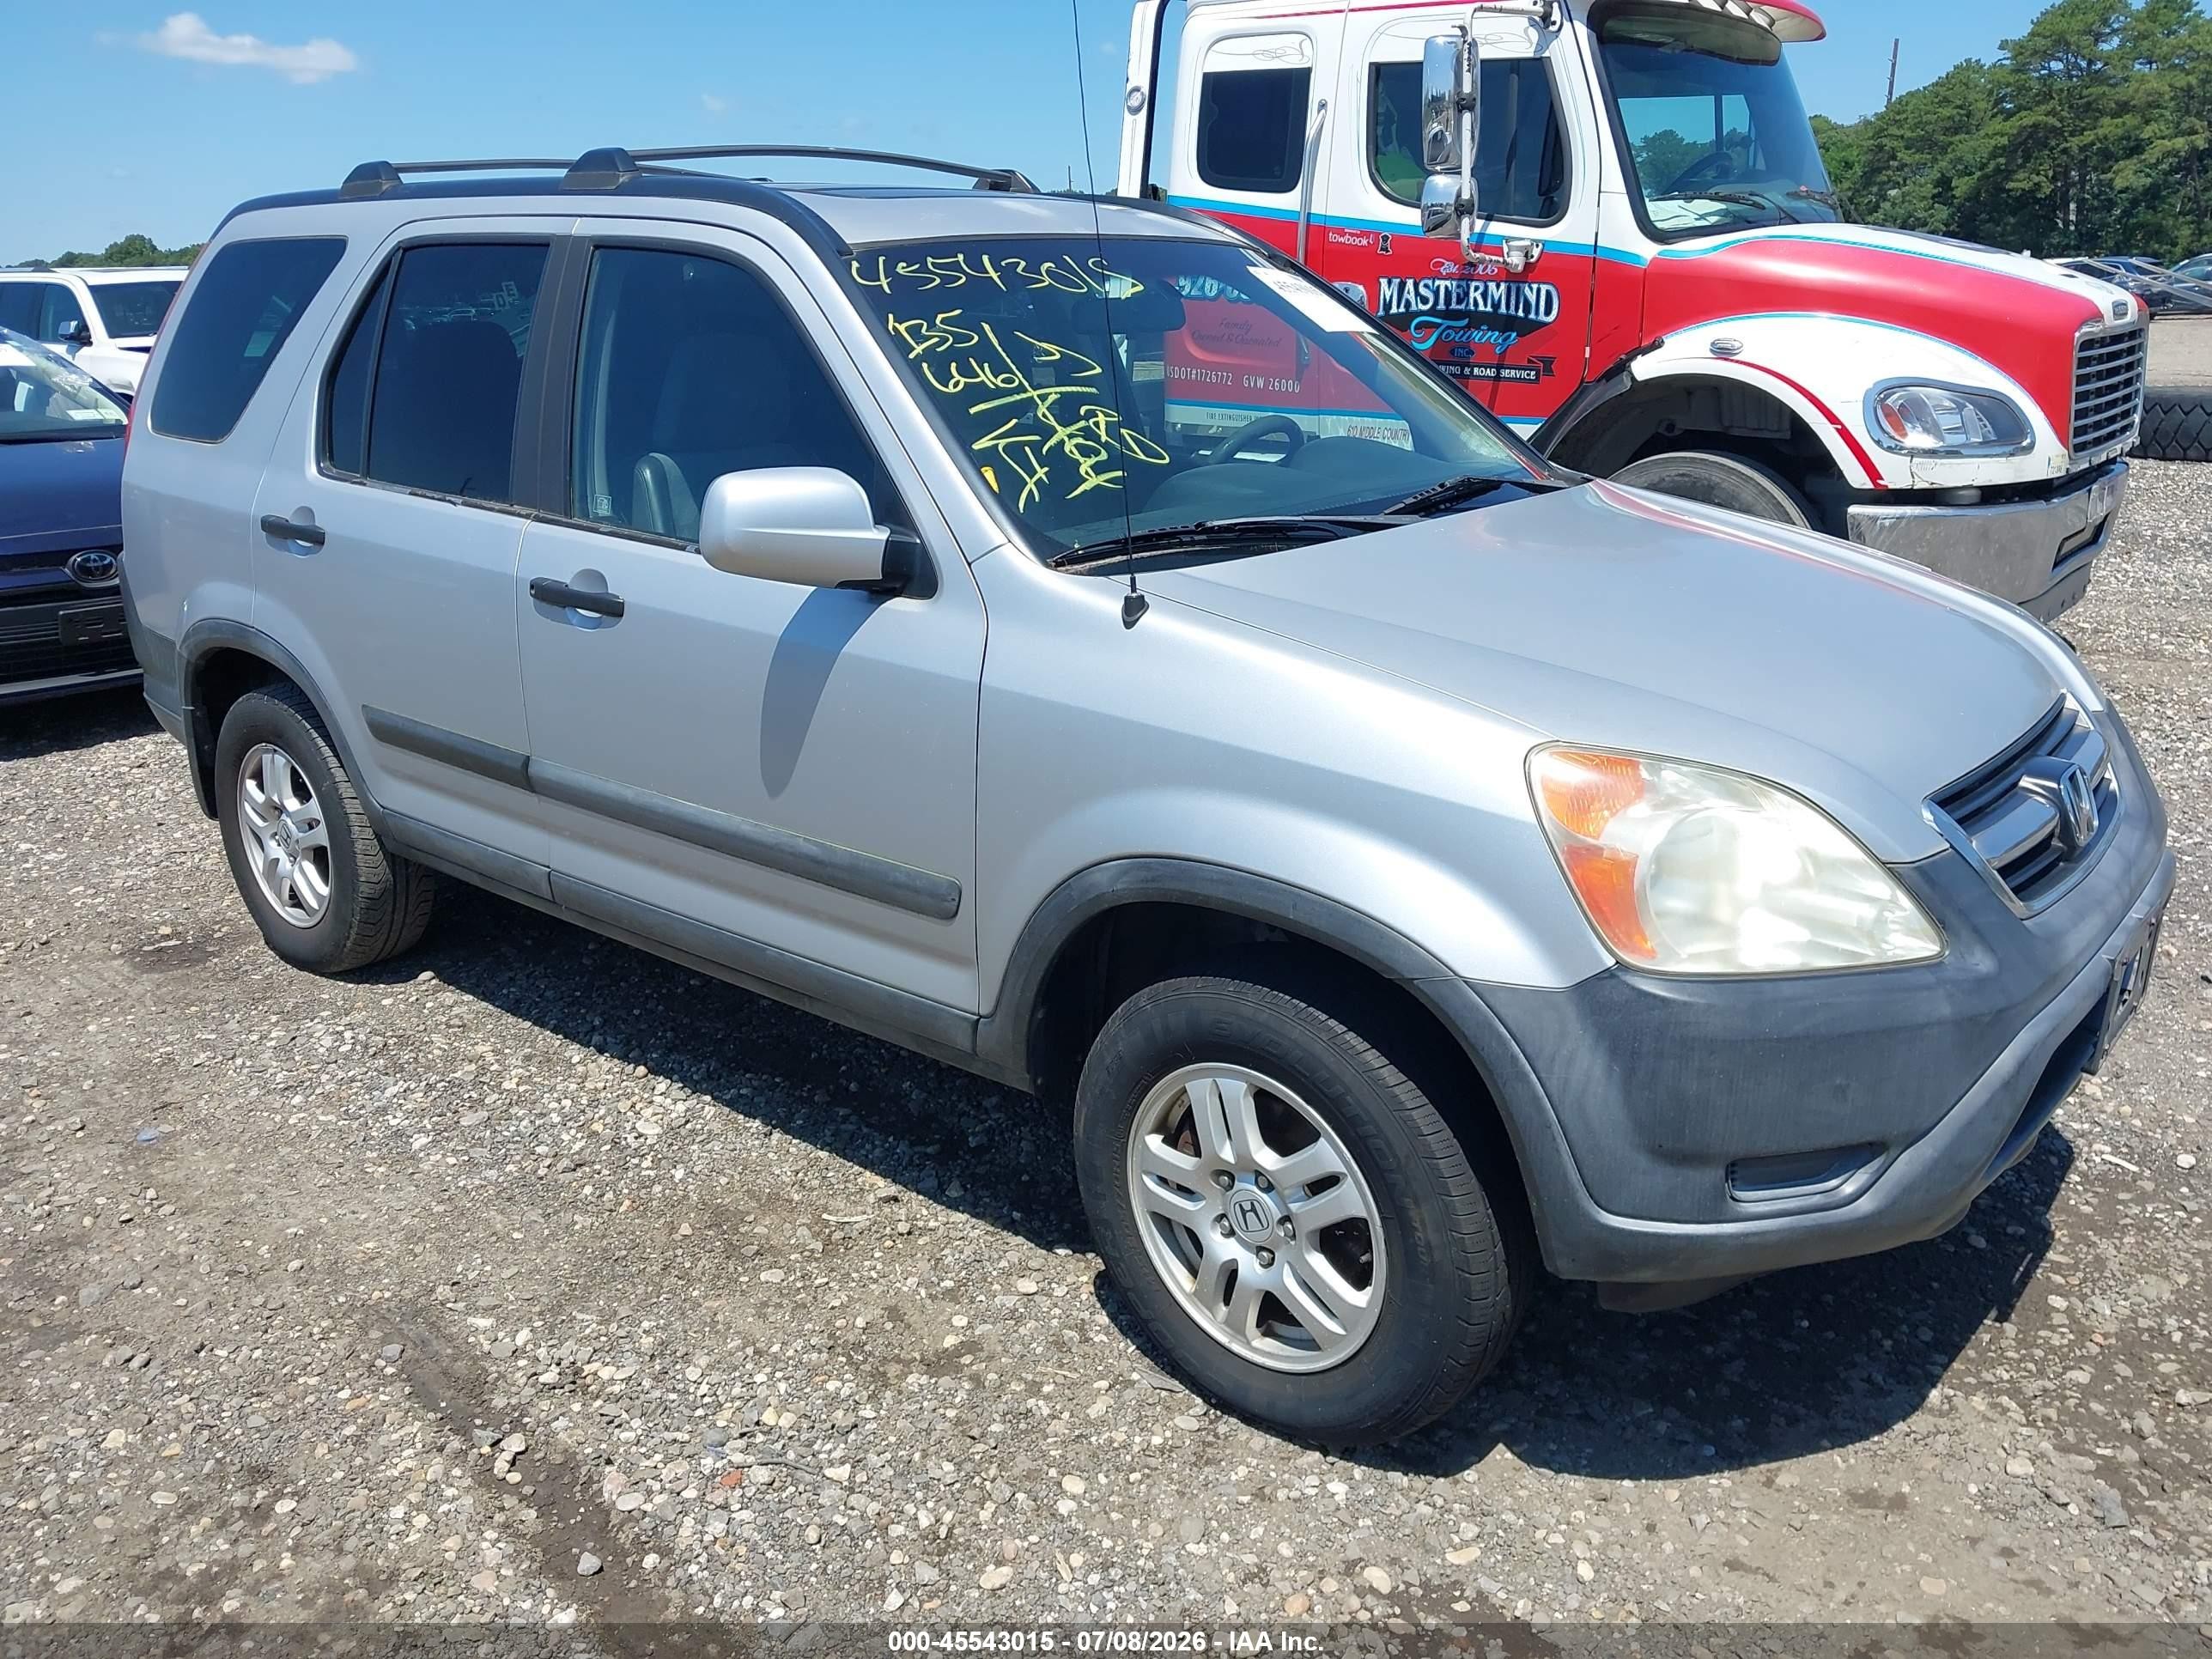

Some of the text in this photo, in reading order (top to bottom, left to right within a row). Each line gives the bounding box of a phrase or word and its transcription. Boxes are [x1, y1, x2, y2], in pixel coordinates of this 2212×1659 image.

[1328, 231, 1369, 247] towbook
[1376, 276, 1560, 324] MASTERMIND
[1410, 315, 1519, 355] Towing
[1463, 366, 1471, 375] &
[1473, 367, 1498, 378] ROAD
[1499, 368, 1536, 380] SERVICE
[1243, 374, 1265, 390] GVW
[1267, 378, 1301, 393] 26000
[1359, 425, 1382, 440] MIDDLE
